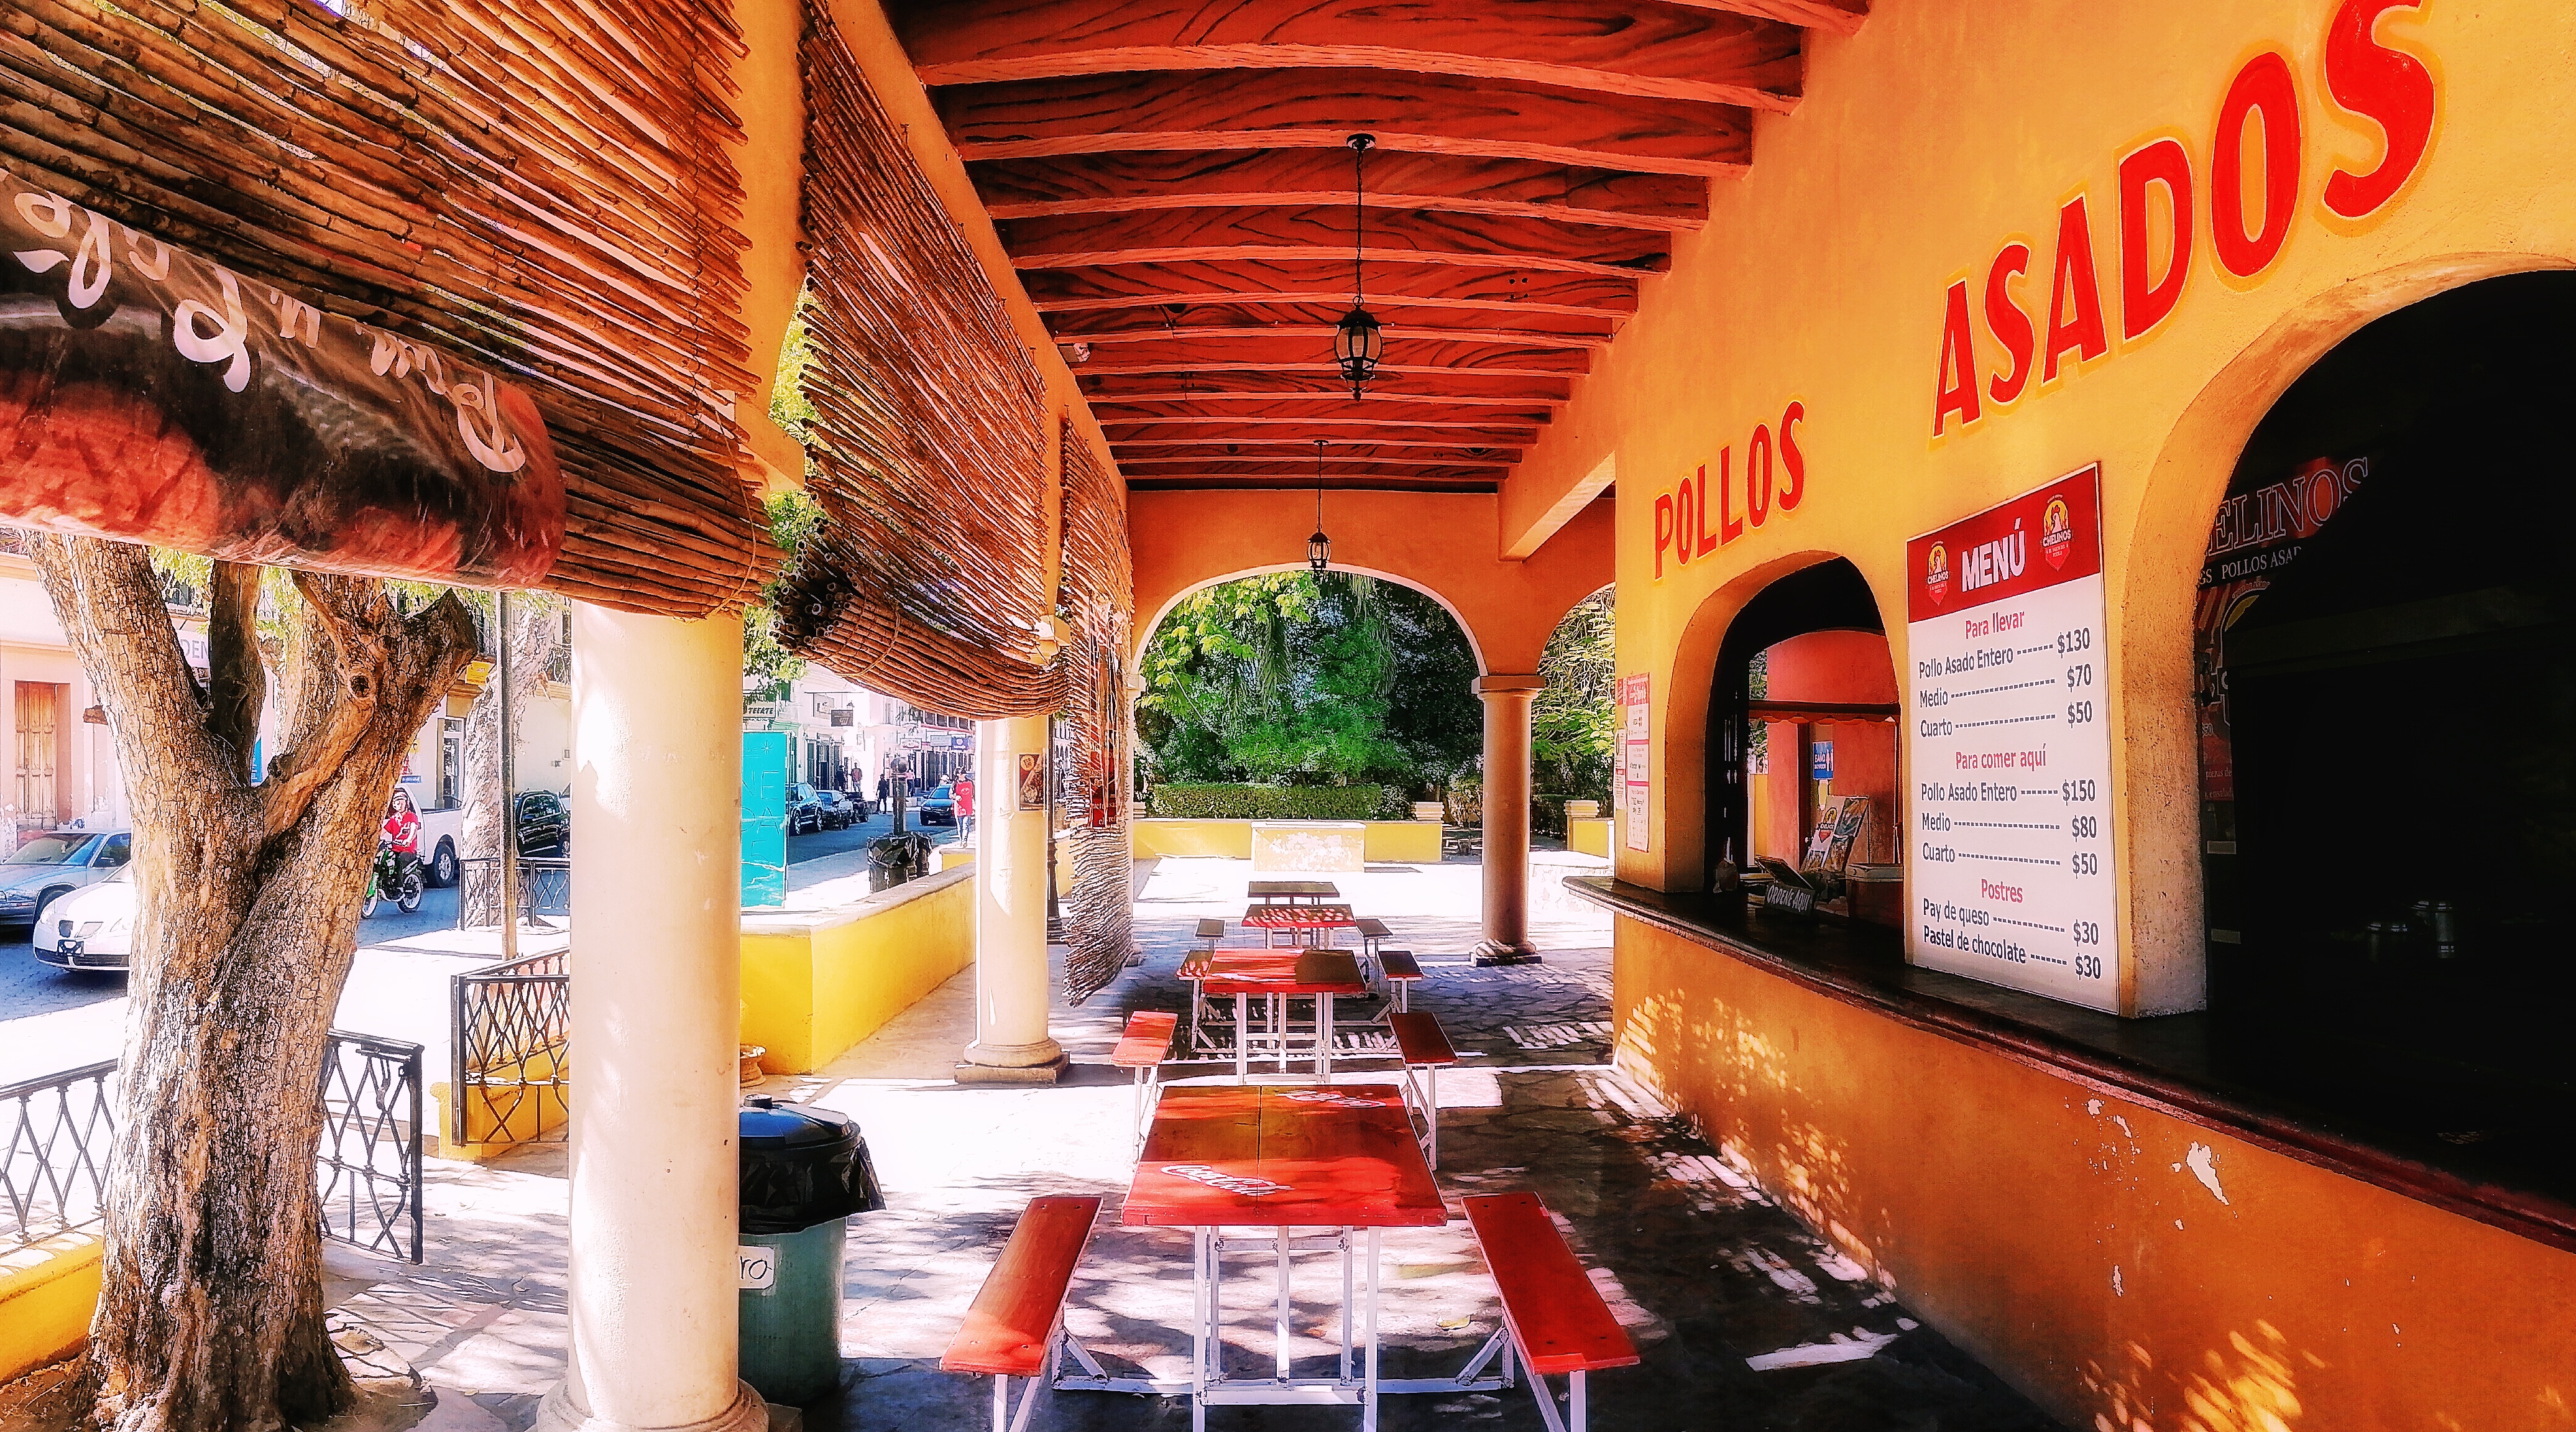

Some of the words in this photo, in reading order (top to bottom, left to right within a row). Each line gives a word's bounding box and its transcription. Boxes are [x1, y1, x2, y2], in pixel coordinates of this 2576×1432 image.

[1932, 0, 2436, 439] ASADOS
[1654, 400, 1805, 581] POLLOS
[1962, 517, 2026, 592] MENÚ
[2042, 529, 2071, 547] CHELINOS
[2221, 554, 2267, 579] POLLOS
[1965, 620, 1989, 639] Para
[1992, 612, 2025, 634] llevar
[1919, 658, 1943, 679] Pollo
[1944, 652, 1975, 674] Asado
[1977, 648, 2013, 669] Entero
[2057, 628, 2091, 658] $130
[1920, 687, 1948, 708] Medio
[2067, 664, 2092, 692] $70
[1920, 718, 1953, 737] Cuarto
[2068, 700, 2092, 728] $50
[1956, 751, 1978, 769] Para
[1981, 751, 2017, 769] comer
[2020, 743, 2046, 771] aquí
[1921, 782, 1945, 801] Pollo
[1948, 782, 1978, 801] Asado
[1981, 782, 2017, 801] Entero
[2062, 779, 2095, 806] $150
[1922, 812, 1951, 832] Medio
[2072, 815, 2097, 842] $80
[1923, 842, 1956, 863] Cuarto
[2072, 851, 2097, 879] $50
[1767, 884, 1794, 907] ORDENE
[1981, 878, 2023, 903] Postres
[1923, 897, 1941, 922] Pay
[1944, 901, 1957, 920] de
[1959, 907, 1990, 927] queso
[2073, 919, 2099, 946] $30
[1923, 925, 1954, 948] Pastel
[1957, 931, 1969, 952] de
[1972, 934, 2026, 963] chocolate
[2075, 953, 2101, 980] $30
[1161, 1164, 1296, 1196] Coca-Cola
